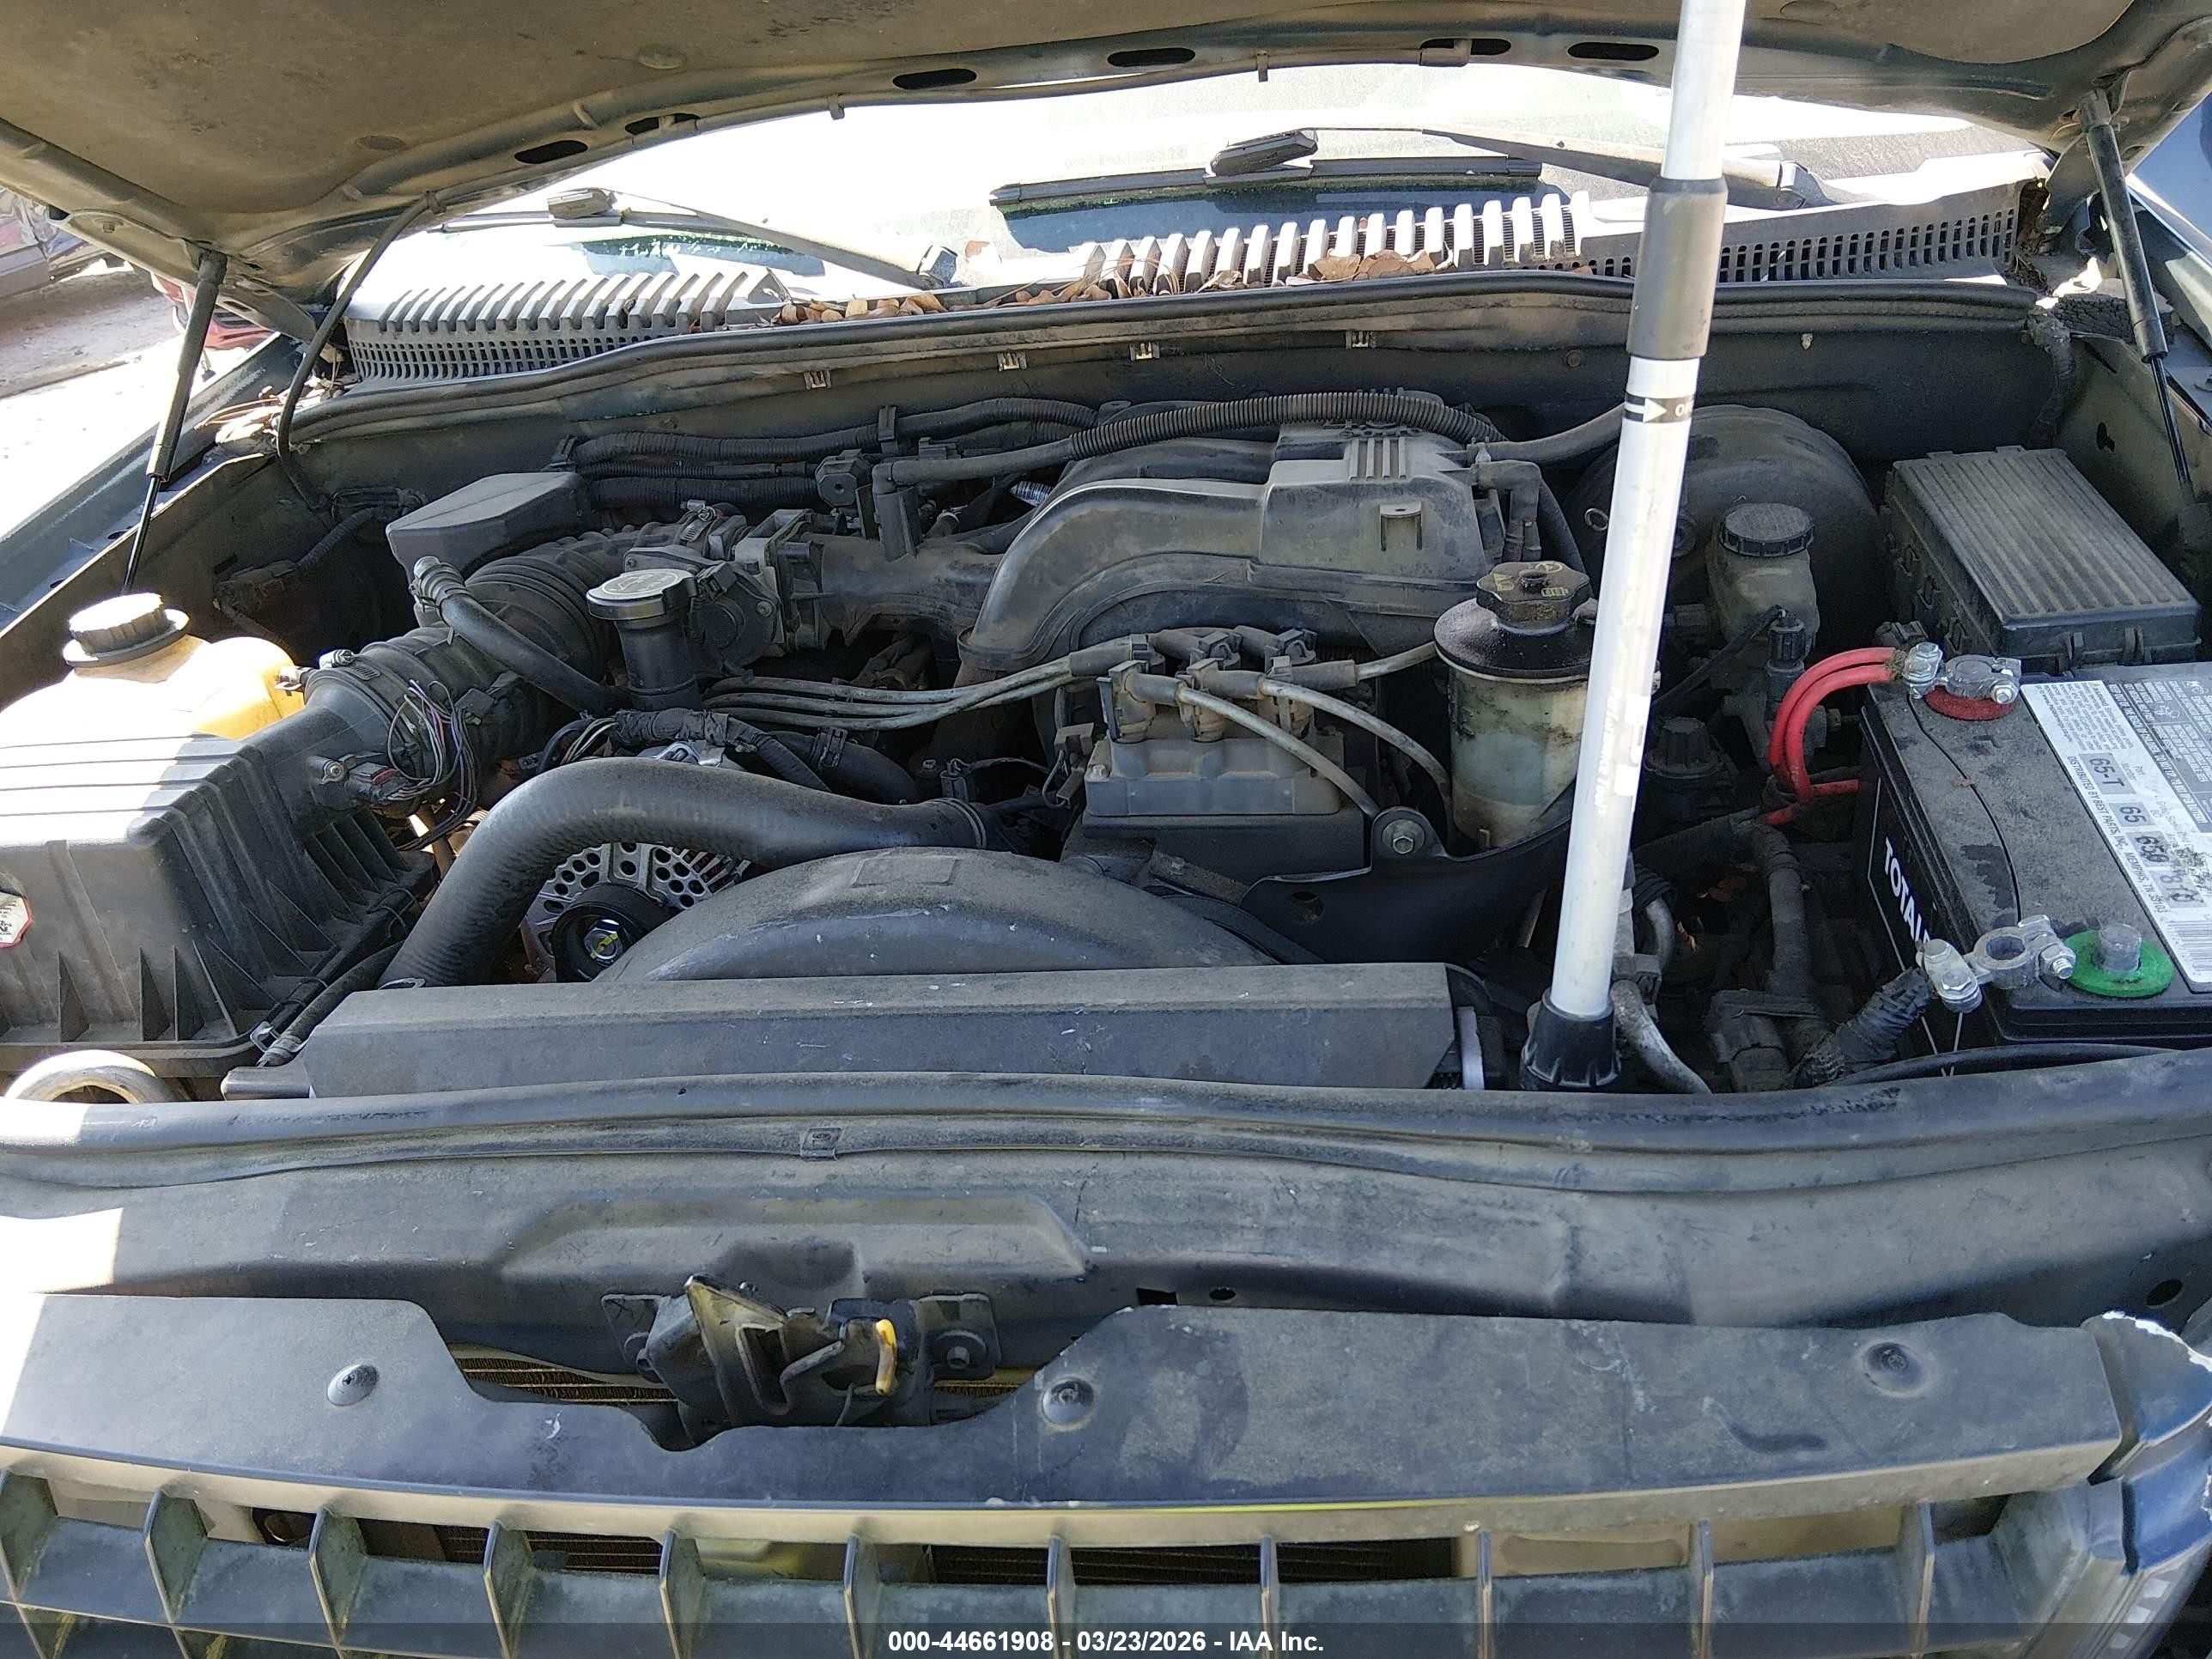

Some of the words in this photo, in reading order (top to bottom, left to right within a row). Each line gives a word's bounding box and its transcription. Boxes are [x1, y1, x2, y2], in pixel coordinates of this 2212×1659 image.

[2088, 757, 2124, 787] 65-T
[2067, 756, 2094, 790] DISTRIBUTED
[2087, 791, 2100, 799] BY
[2094, 799, 2109, 814] BEST
[2143, 884, 2154, 892] TN
[2119, 805, 2147, 823] 65
[2135, 835, 2170, 863] 650
